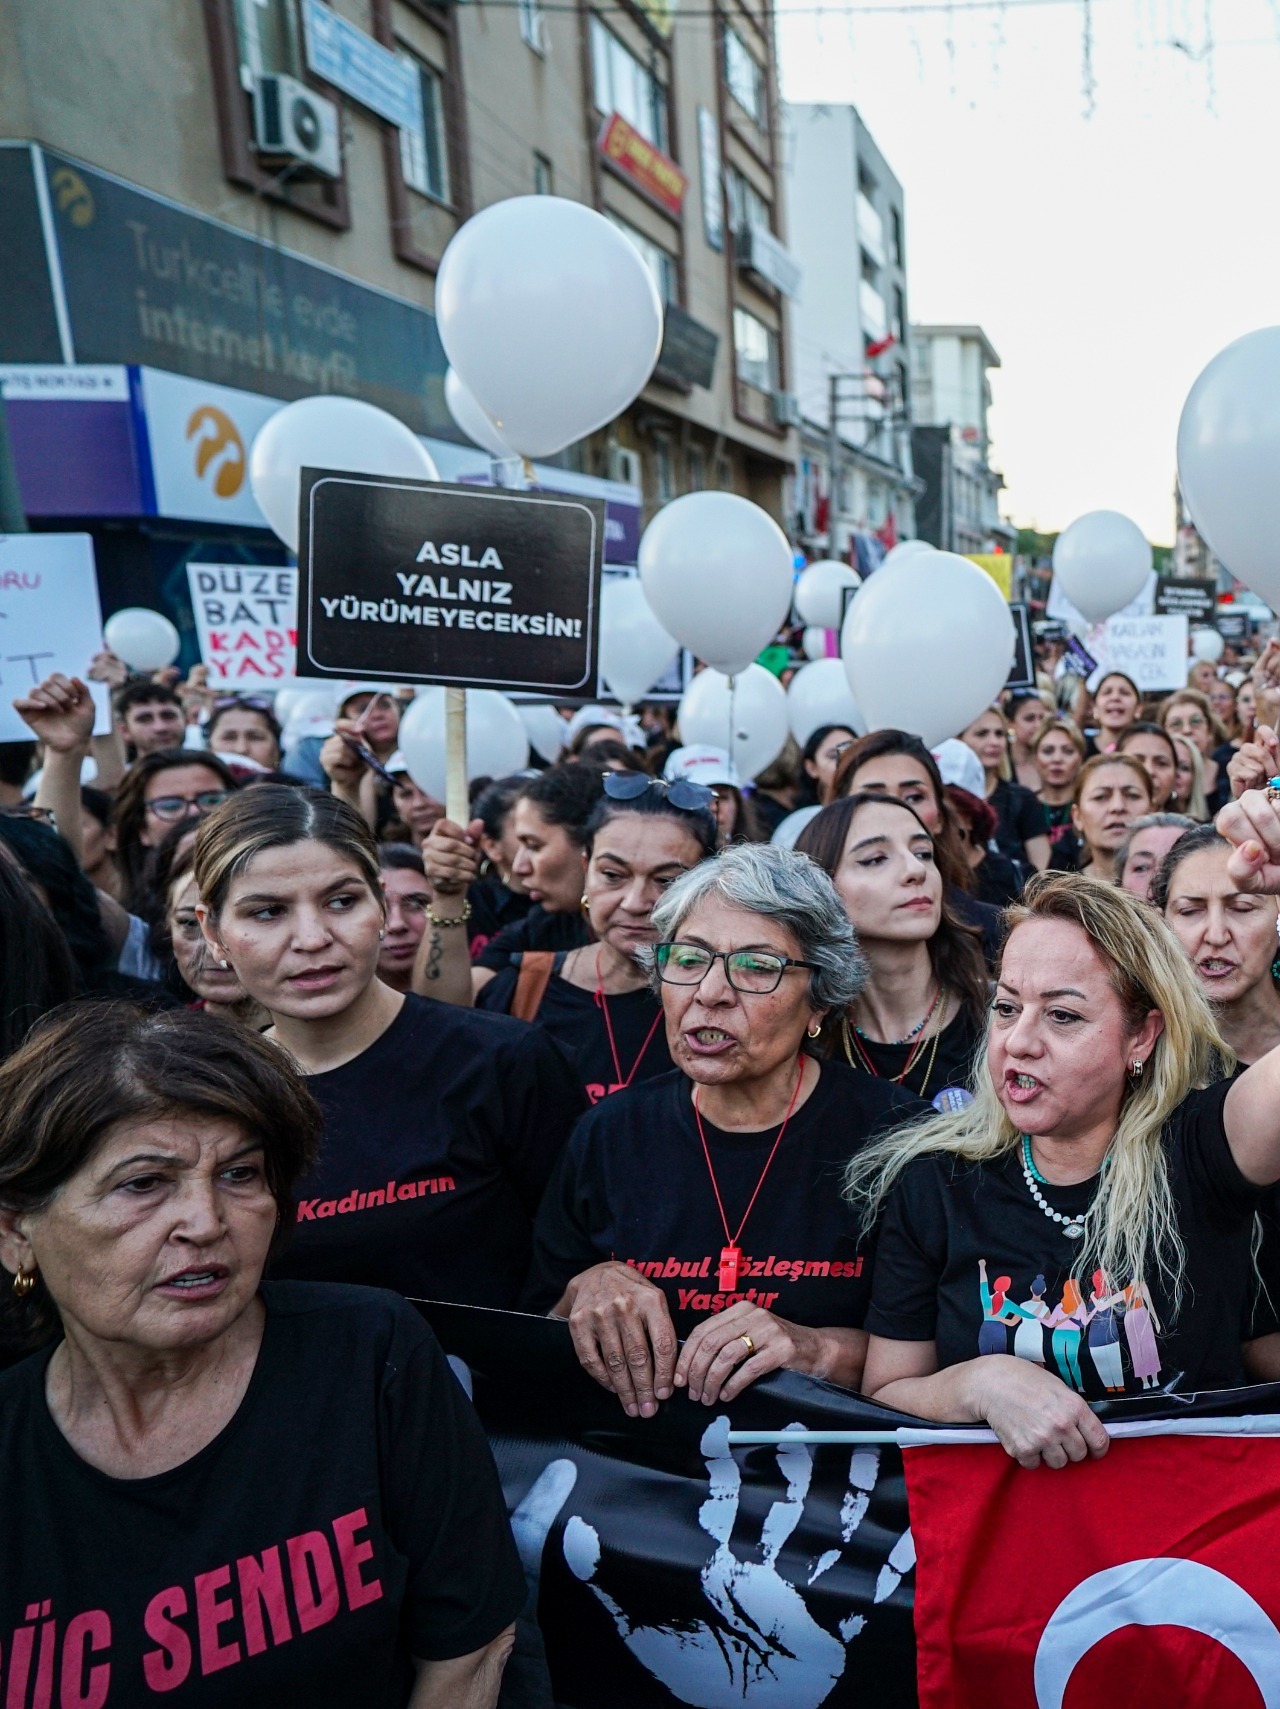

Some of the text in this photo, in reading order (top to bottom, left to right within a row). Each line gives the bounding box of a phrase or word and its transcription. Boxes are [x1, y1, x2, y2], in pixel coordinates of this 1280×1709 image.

[415, 541, 504, 570] ASLA
[396, 572, 513, 605] YALNIZ
[320, 595, 582, 638] YÜRÜMEYECEKSİN!
[297, 1176, 456, 1222] Kadınların
[719, 1255, 864, 1282] özleşmesi
[142, 1506, 384, 1693] SENDE
